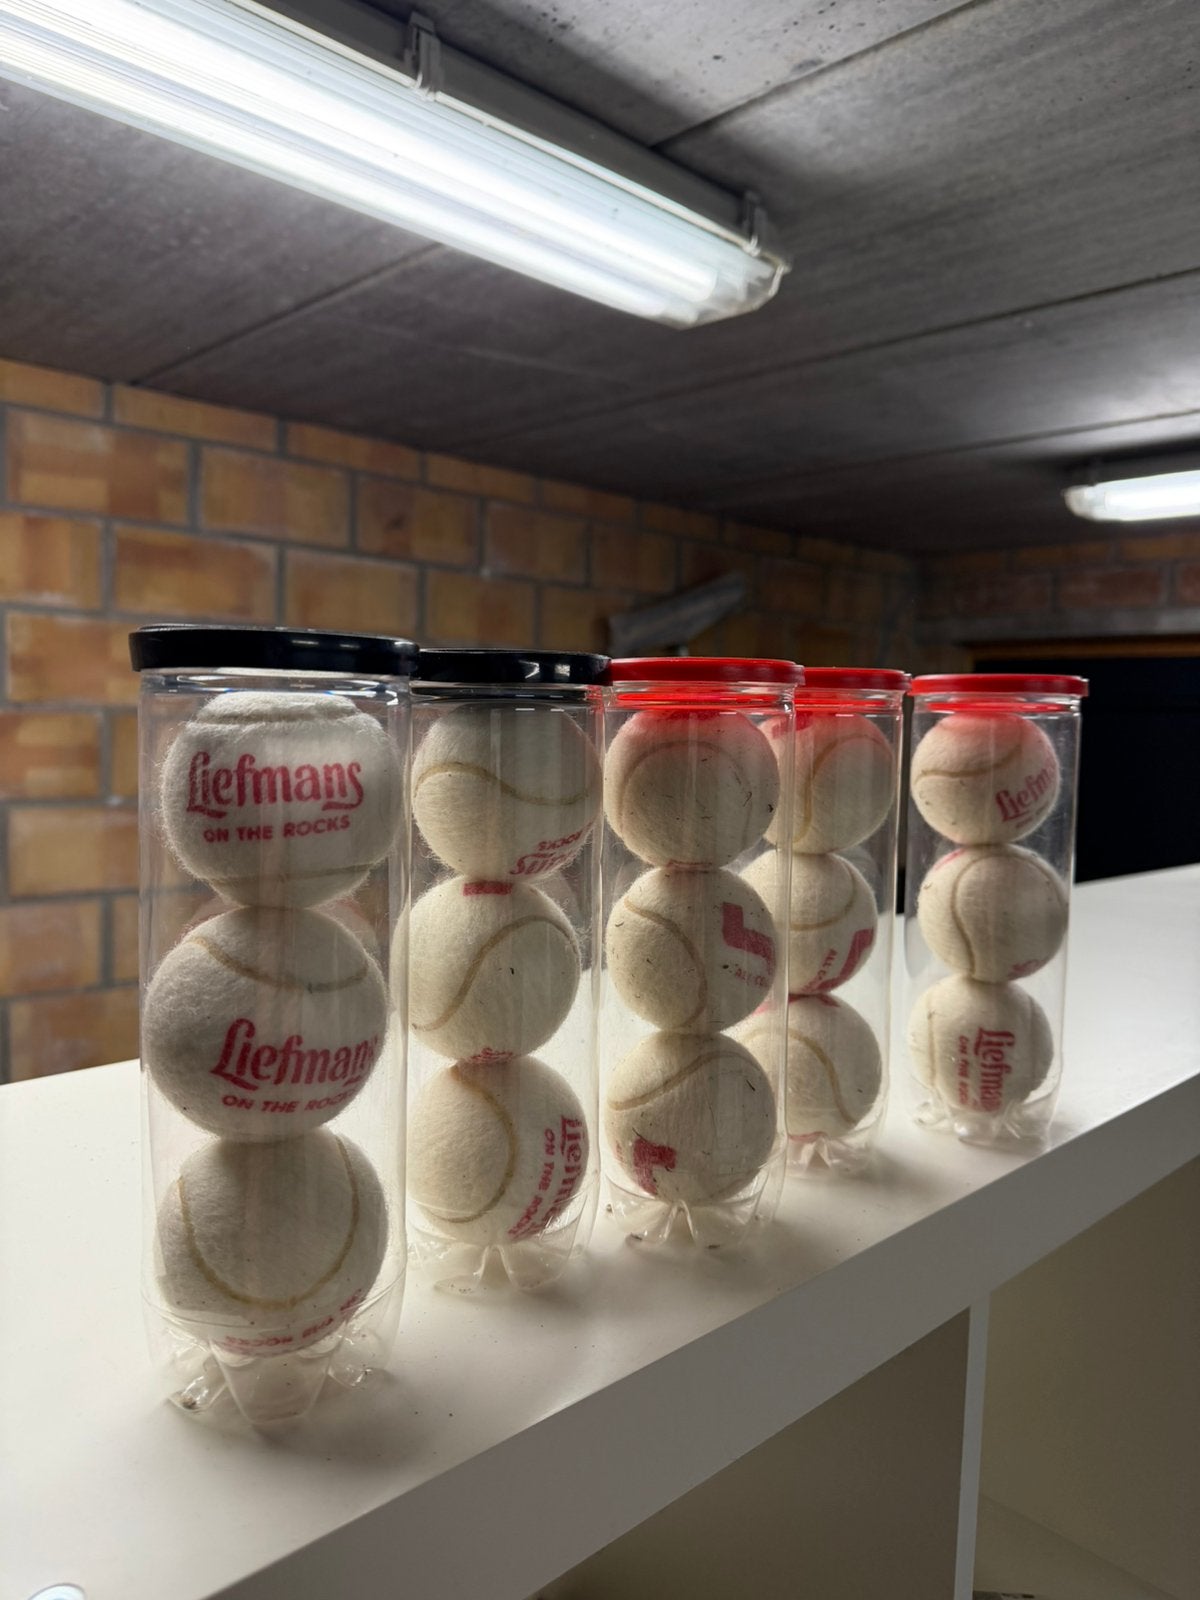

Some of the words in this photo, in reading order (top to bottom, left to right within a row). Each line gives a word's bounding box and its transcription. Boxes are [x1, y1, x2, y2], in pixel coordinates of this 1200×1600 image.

[186, 751, 365, 819] Liefmans
[203, 828, 229, 843] ON
[237, 825, 274, 842] THE
[283, 815, 351, 838] ROCKS
[221, 1094, 254, 1111] ON
[260, 1100, 300, 1114] THE
[543, 1127, 557, 1157] ON
